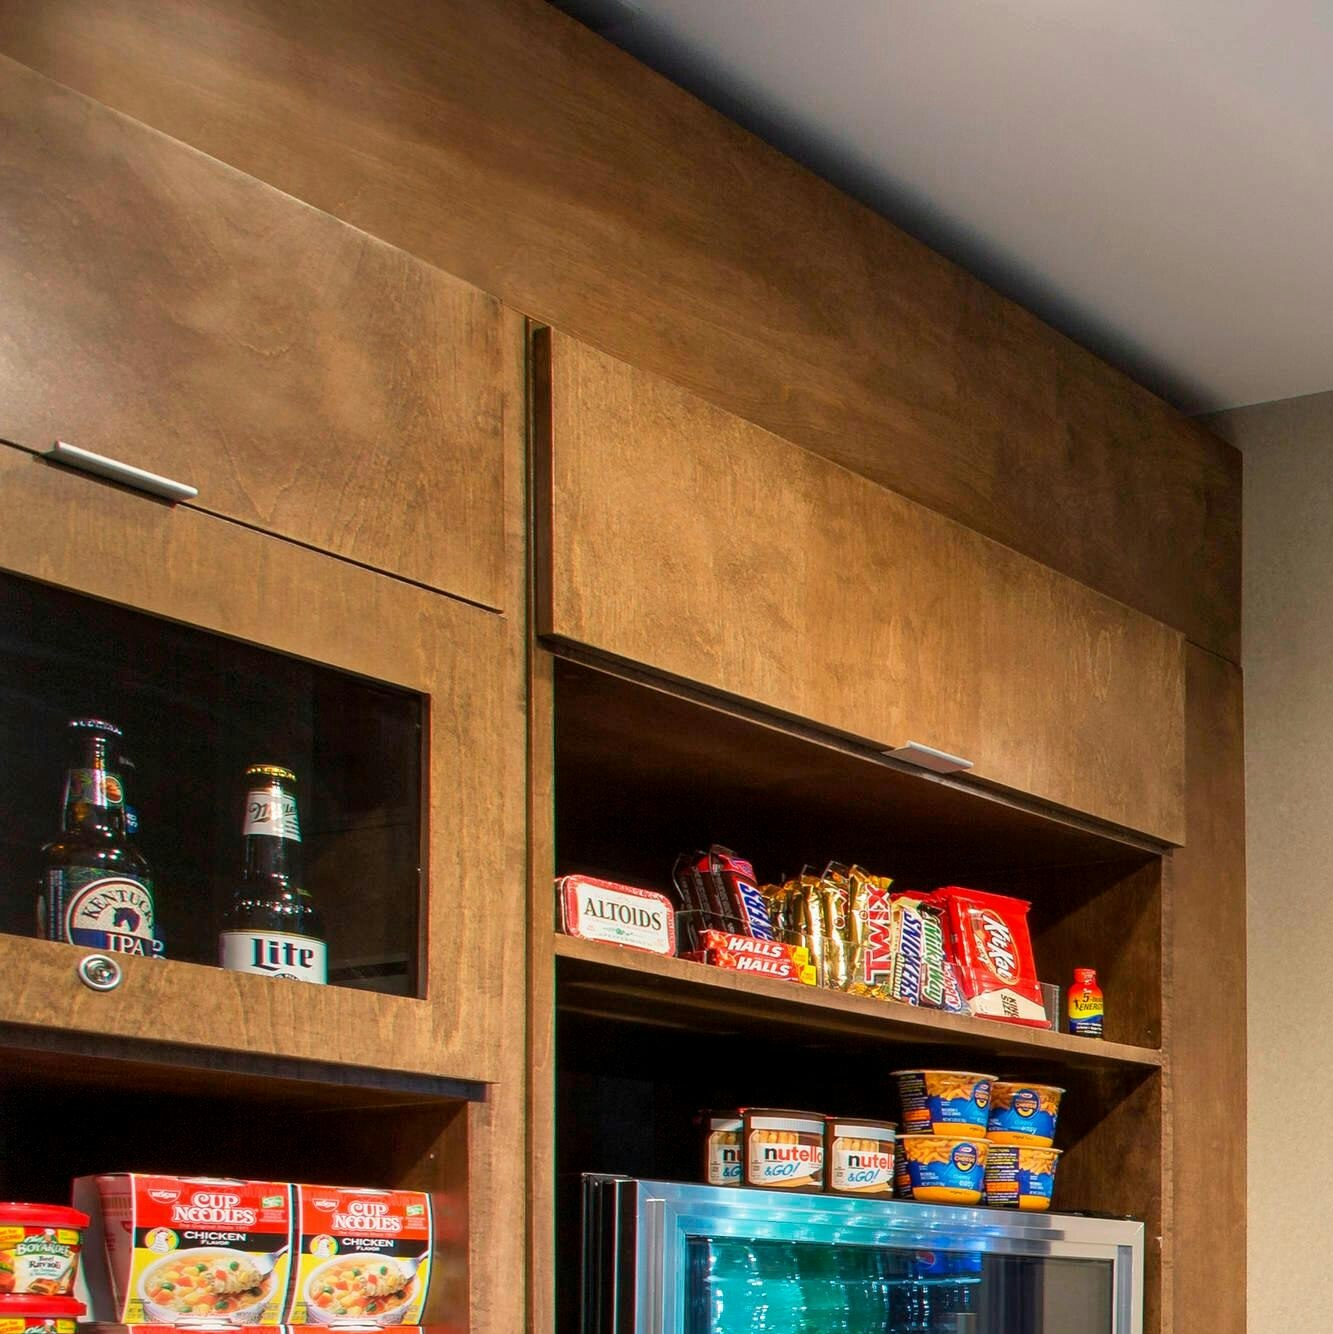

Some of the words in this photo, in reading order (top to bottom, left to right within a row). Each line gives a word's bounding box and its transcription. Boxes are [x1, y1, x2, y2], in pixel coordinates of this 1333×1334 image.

[583, 896, 663, 931] ALTOIDS
[864, 883, 891, 985] TWIX
[106, 932, 146, 956] IPA
[727, 936, 785, 958] HALLS
[250, 937, 315, 972] Lite
[900, 910, 922, 1007] SNICKERS
[736, 956, 793, 977] HALLS
[763, 1163, 800, 1178] &GO!
[847, 1168, 879, 1183] &GO!
[192, 1193, 240, 1208] CUP
[348, 1201, 388, 1216] CUP
[173, 1206, 256, 1225] NOODLES
[332, 1214, 403, 1232] NOODLES
[184, 1231, 247, 1241] CHICKEN
[342, 1237, 394, 1247] CHICKEN
[16, 1242, 70, 1256] BOYARDEE
